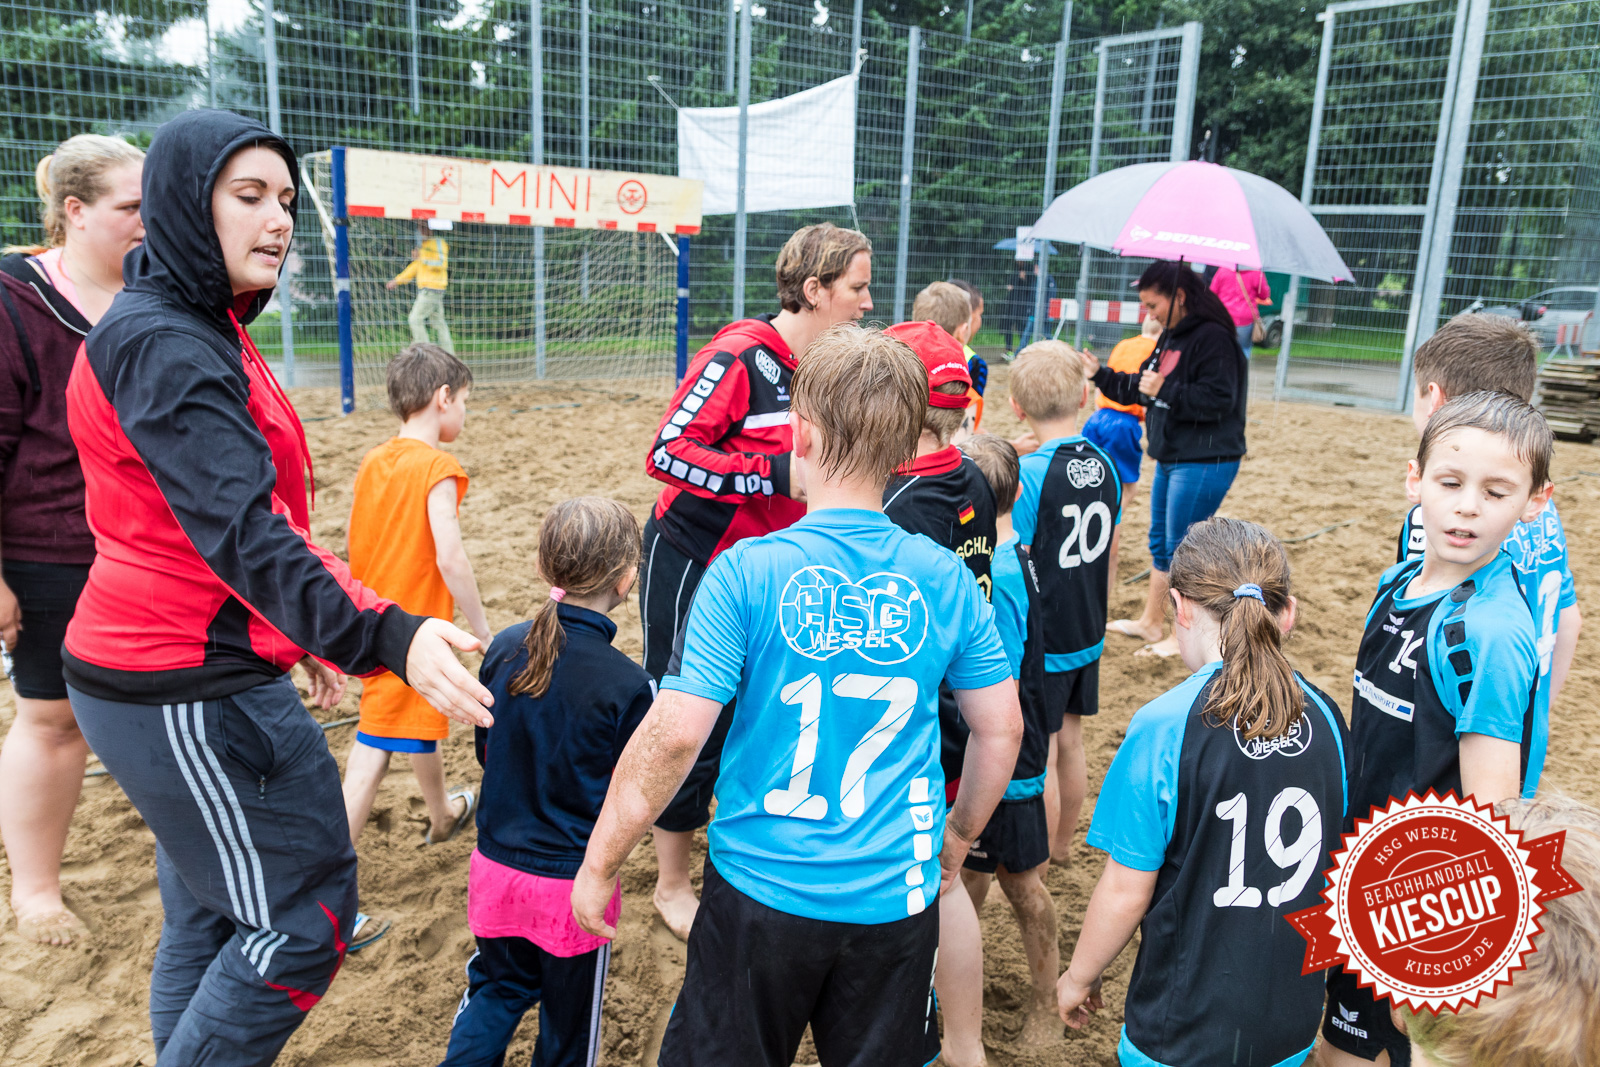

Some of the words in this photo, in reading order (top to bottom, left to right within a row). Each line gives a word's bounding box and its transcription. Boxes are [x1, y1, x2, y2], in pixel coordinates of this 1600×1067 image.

[491, 168, 591, 212] MINI
[1153, 231, 1250, 252] DUNLOP
[1059, 501, 1112, 569] 20
[798, 583, 911, 637] HSG
[809, 629, 891, 651] WESEL
[763, 672, 918, 820] 17
[1252, 735, 1294, 754] WESEL
[1213, 787, 1323, 908] 19
[1331, 1015, 1368, 1039] erima
